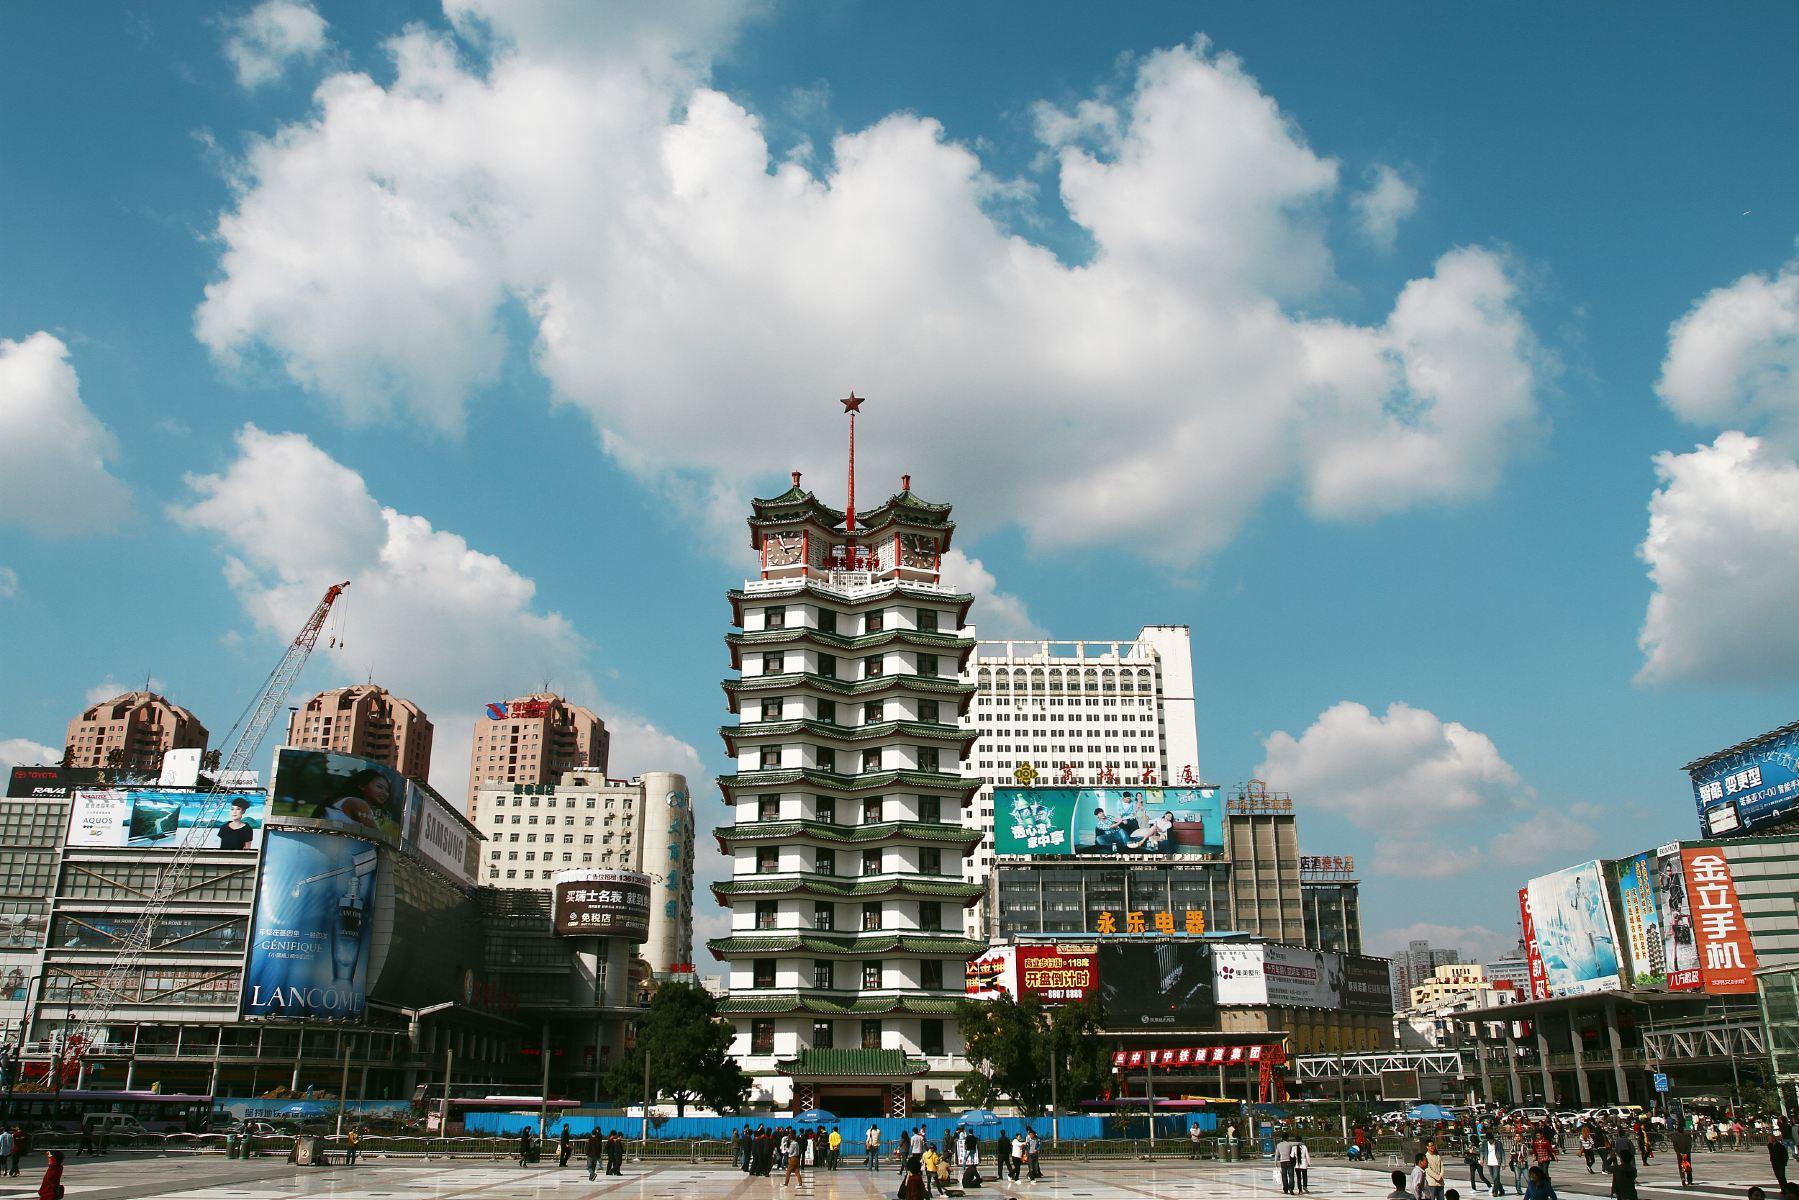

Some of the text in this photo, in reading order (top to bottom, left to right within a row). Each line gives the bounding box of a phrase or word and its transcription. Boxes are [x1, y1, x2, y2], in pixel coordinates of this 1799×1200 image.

[1060, 764, 1198, 785] 商城大厦
[83, 817, 113, 825] AQUOS
[424, 812, 463, 863] SAMSUNG
[566, 889, 623, 903] 买瑞士名表
[581, 912, 612, 923] 免税店
[1690, 855, 1746, 969] 金立手机
[1097, 911, 1204, 934] 永乐电器
[261, 939, 324, 953] GÉNIFIQUE
[1025, 970, 1090, 987] 开盘倒计时
[251, 984, 361, 1012] LANCÔME
